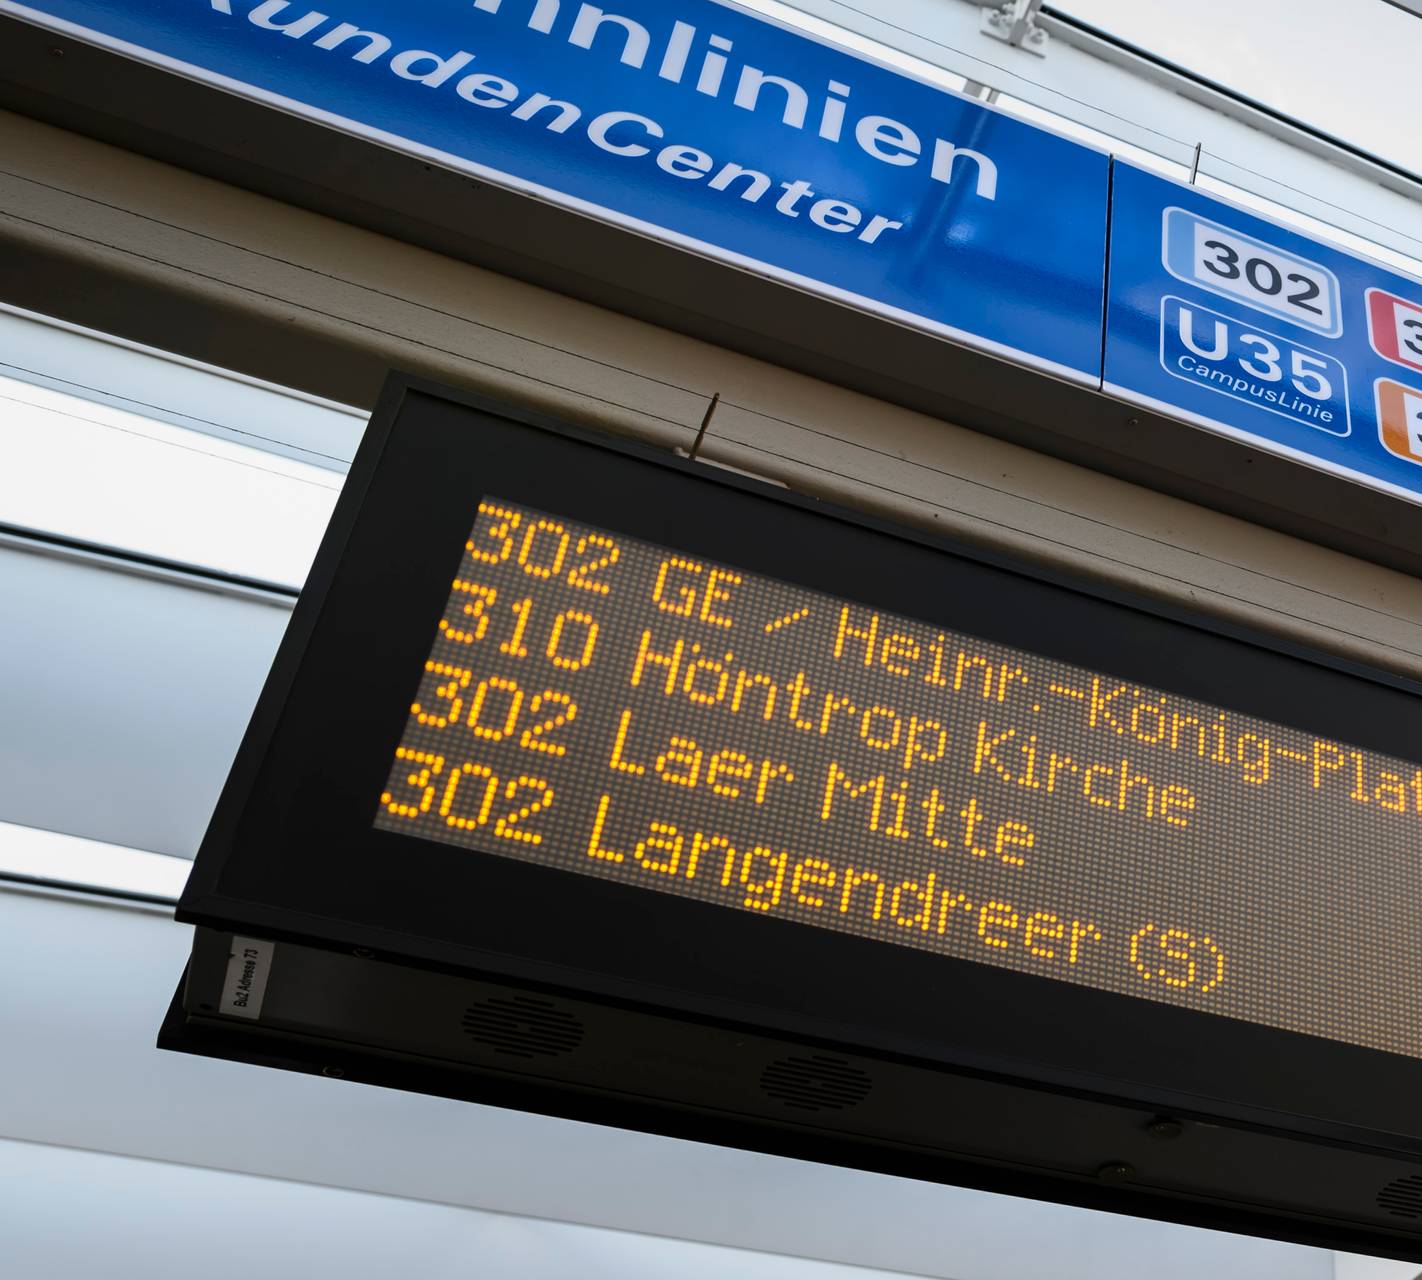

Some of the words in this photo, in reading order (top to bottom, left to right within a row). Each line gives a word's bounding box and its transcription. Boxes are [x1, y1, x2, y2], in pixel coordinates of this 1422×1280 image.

[210, 0, 903, 244] undenCenter
[1203, 240, 1323, 315] 302
[1177, 355, 1334, 423] CampusLinie
[1179, 307, 1333, 401] U35
[465, 503, 620, 595] 302
[652, 558, 742, 628] GE
[439, 579, 599, 671] 310
[630, 630, 947, 769] Höntrop
[973, 721, 1195, 827] Kirche
[411, 661, 577, 756] 302
[609, 709, 794, 804] Laer
[821, 763, 1034, 866] Mitte
[381, 747, 554, 845] 302
[587, 795, 1101, 963] Langendreer
[1129, 923, 1225, 992] (S)
[236, 959, 258, 992] Adresse
[243, 948, 258, 959] 73
